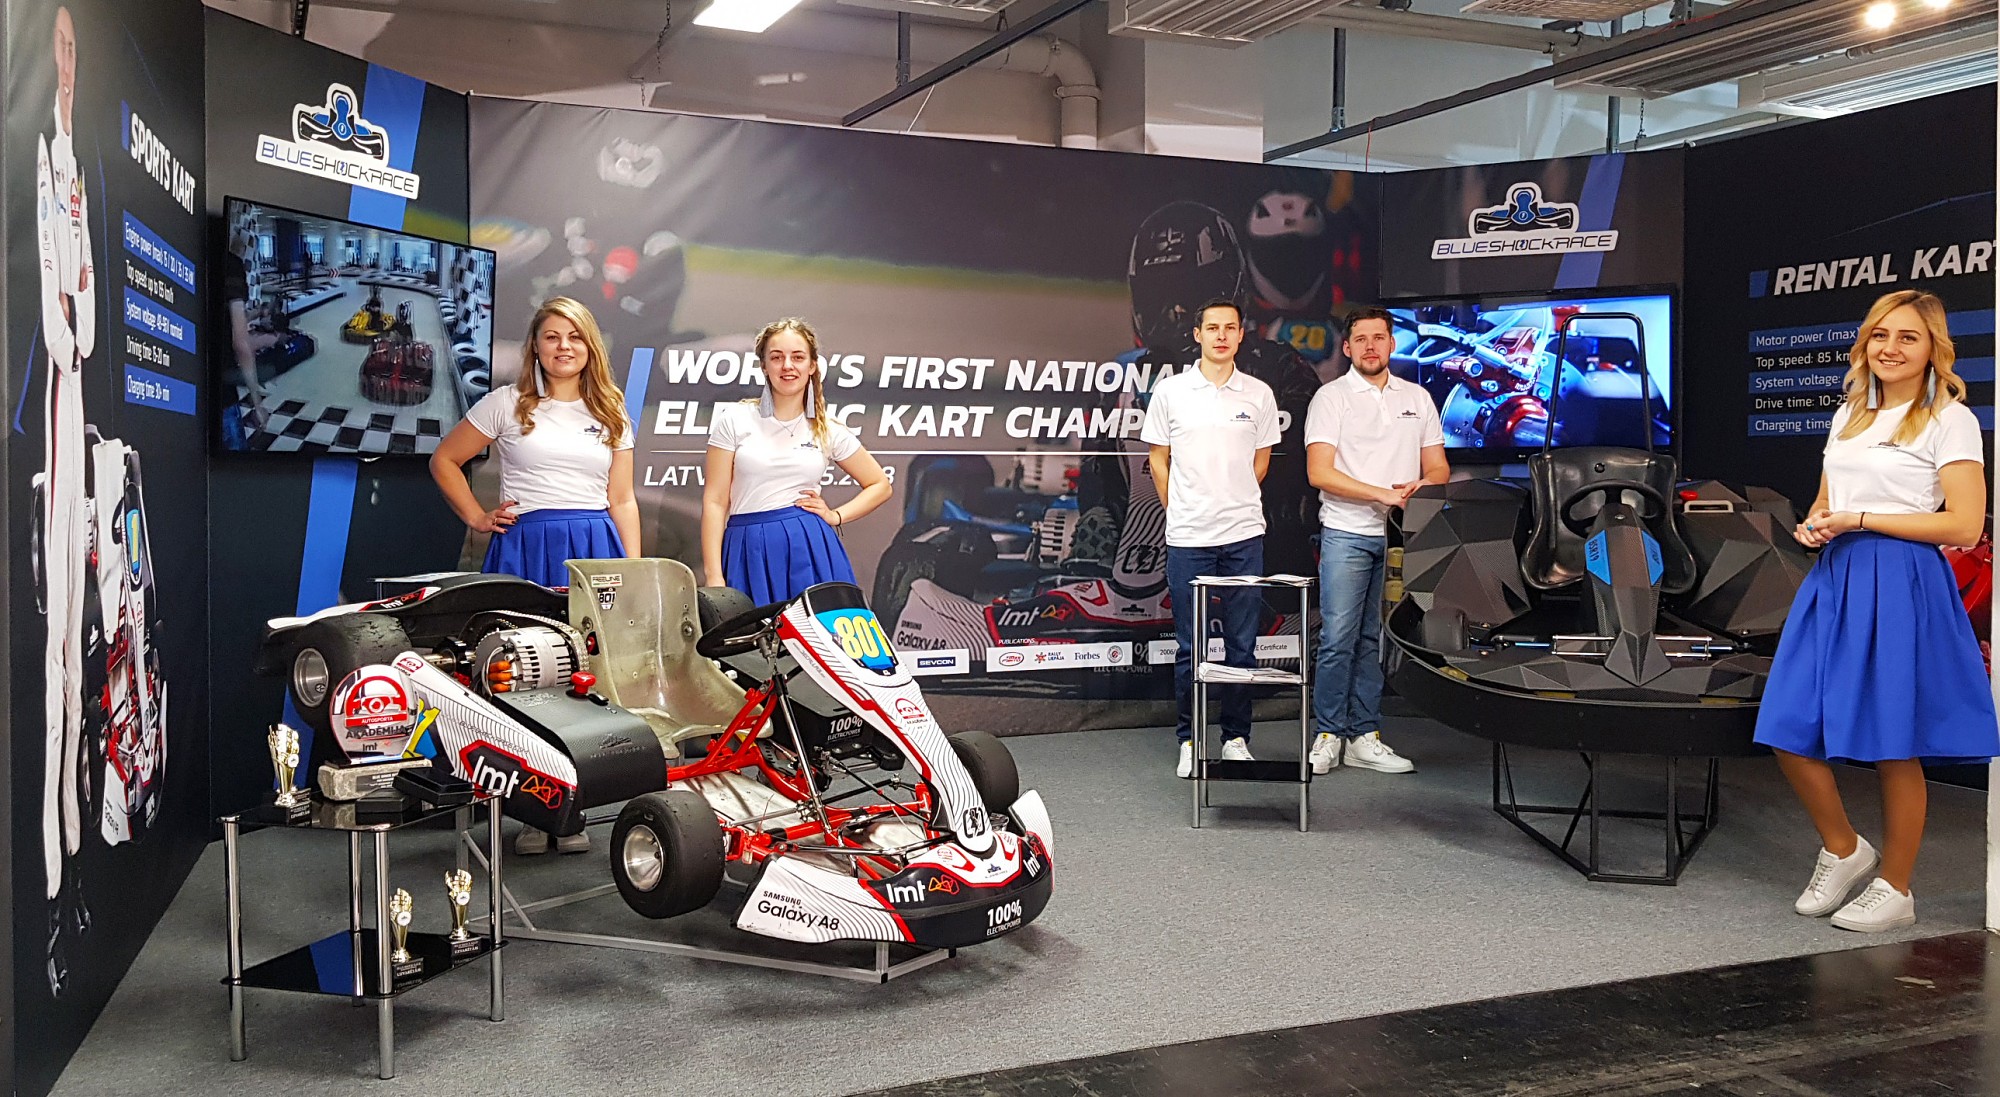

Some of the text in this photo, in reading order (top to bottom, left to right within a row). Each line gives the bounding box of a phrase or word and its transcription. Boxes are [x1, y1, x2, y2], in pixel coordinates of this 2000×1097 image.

[131, 112, 195, 215] SPORTS KART
[261, 141, 415, 193] BLUESHOCKRACE
[1437, 235, 1613, 255] BLUESHOCKRACE
[126, 259, 134, 285] Top
[1773, 239, 1997, 296] RENTAL KAR
[126, 298, 141, 320] System
[1290, 324, 1326, 349] 20
[1756, 336, 1786, 347] Motor
[1790, 332, 1824, 347] power
[126, 335, 142, 361] Driving
[1755, 351, 1850, 369] Top speed: 85 km
[878, 356, 995, 391] FIRST
[1755, 374, 1840, 391] System voltage:
[127, 375, 146, 399] Charging
[1755, 397, 1783, 409] Drive
[1787, 396, 1815, 408] time:
[878, 403, 994, 437] KART
[1755, 419, 1802, 432] Charging
[644, 465, 705, 486] LATV
[599, 593, 616, 603] 801
[998, 608, 1039, 626] lmt
[833, 615, 893, 659] 801
[897, 631, 932, 650] Galaxy
[1260, 643, 1288, 651] Certificate
[1074, 651, 1100, 660] Forbes
[830, 715, 863, 734] 100%
[362, 742, 378, 751] lmt
[472, 755, 519, 798] lmt
[763, 890, 802, 906] SAMSUNG
[886, 880, 926, 903] lmt
[757, 900, 840, 930] Galaxy A8
[987, 899, 1022, 927] 100%
